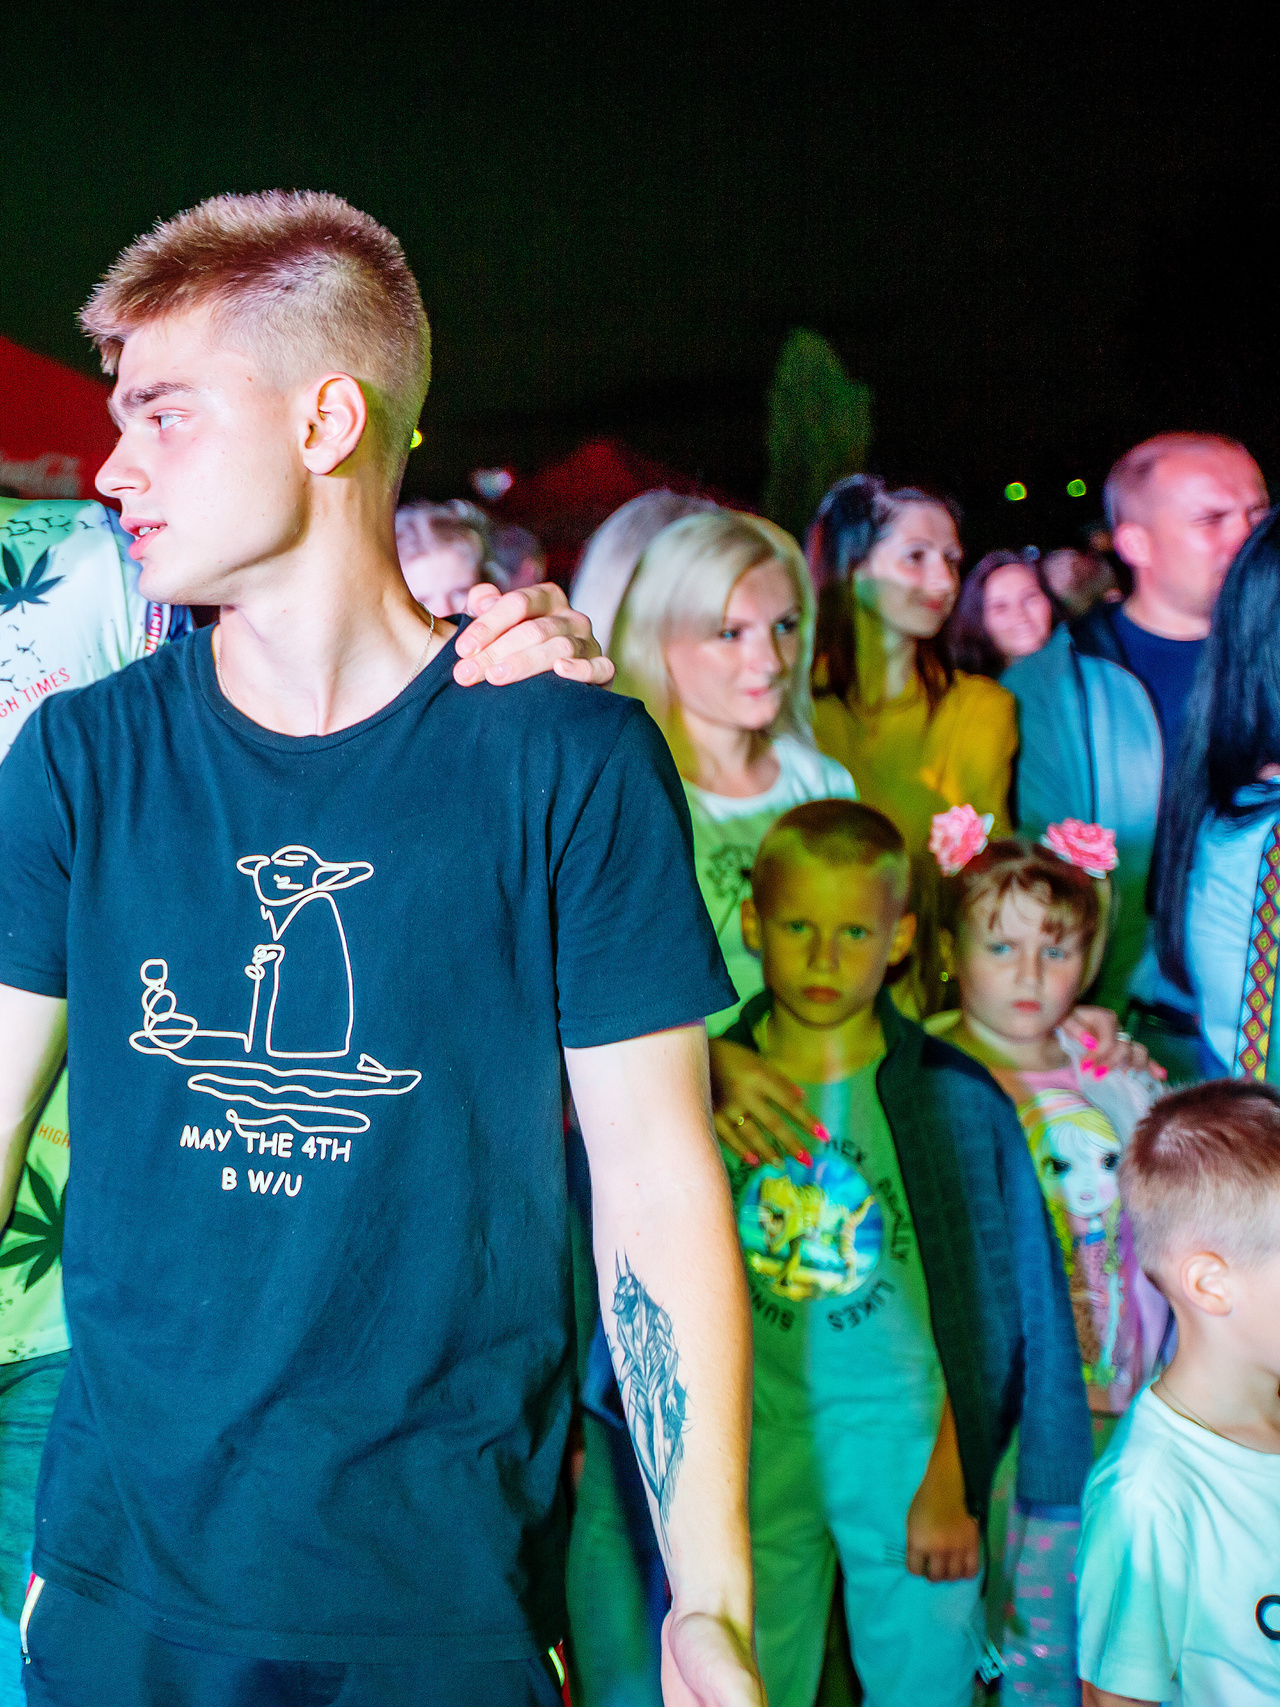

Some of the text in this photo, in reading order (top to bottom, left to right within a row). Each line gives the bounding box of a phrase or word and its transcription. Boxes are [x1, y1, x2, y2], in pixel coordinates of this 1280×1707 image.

[21, 667, 71, 703] TIMES
[179, 1124, 352, 1162] MAY THE 4TH
[221, 1166, 303, 1197] B W/U
